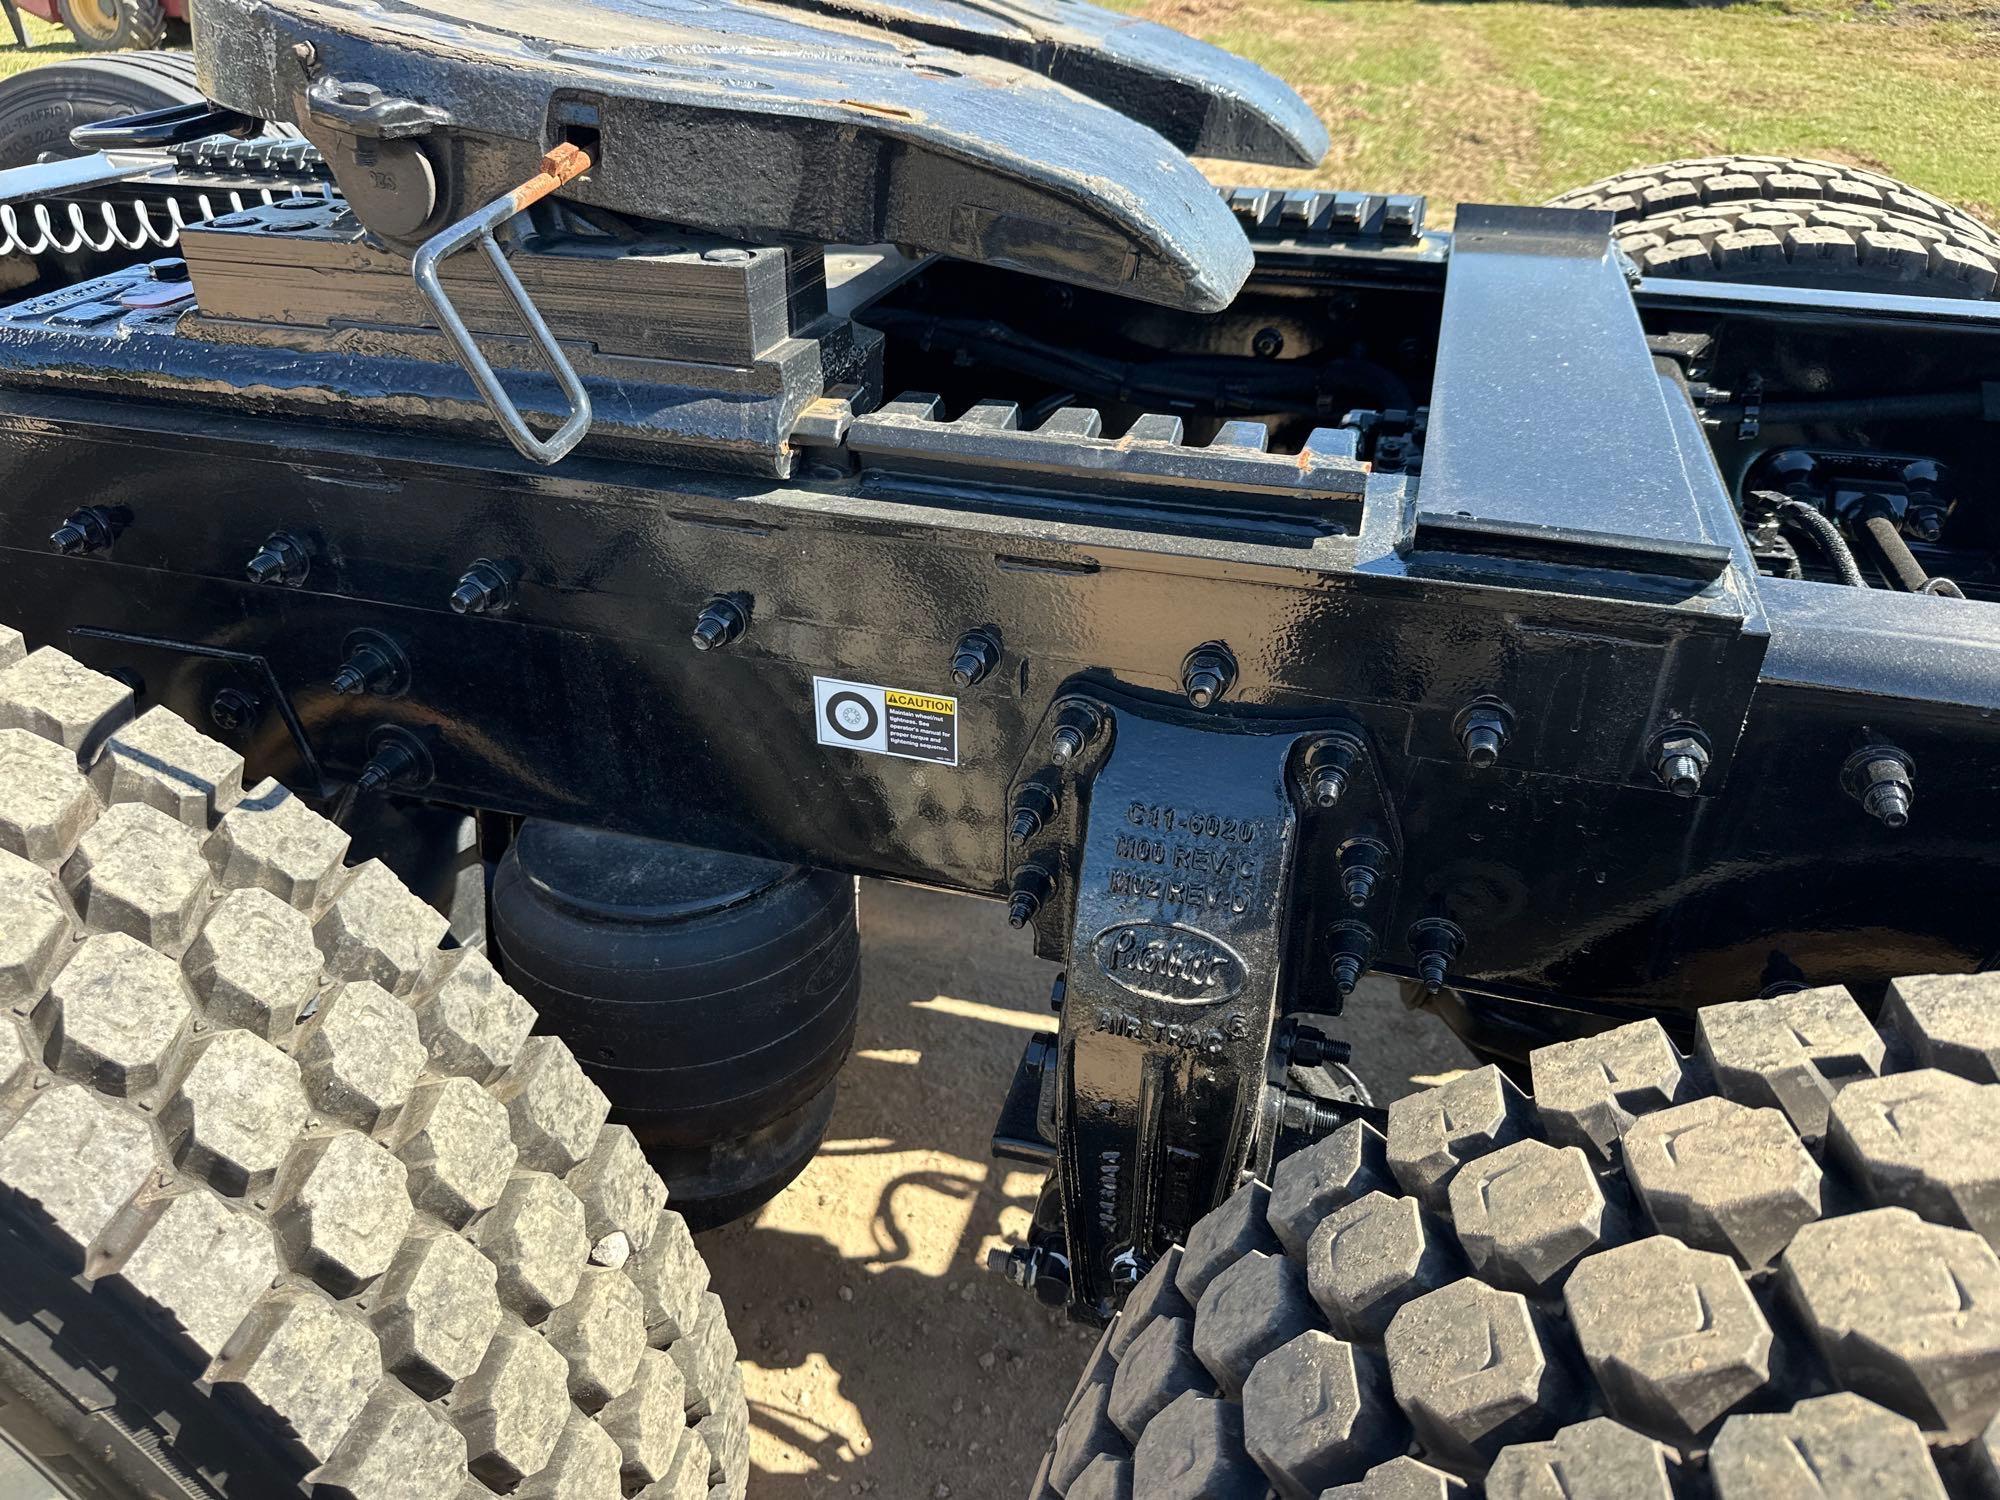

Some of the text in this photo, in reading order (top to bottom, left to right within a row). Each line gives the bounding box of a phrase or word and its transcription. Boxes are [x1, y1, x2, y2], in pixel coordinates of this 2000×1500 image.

[898, 696, 953, 712] CAUTION
[889, 708, 914, 717] Maintain
[889, 716, 917, 725] tightness.
[889, 724, 919, 732] operator's
[890, 738, 949, 752] tightening sequence.
[1167, 881, 1250, 914] REV-D
[1095, 1011, 1143, 1040] AIR
